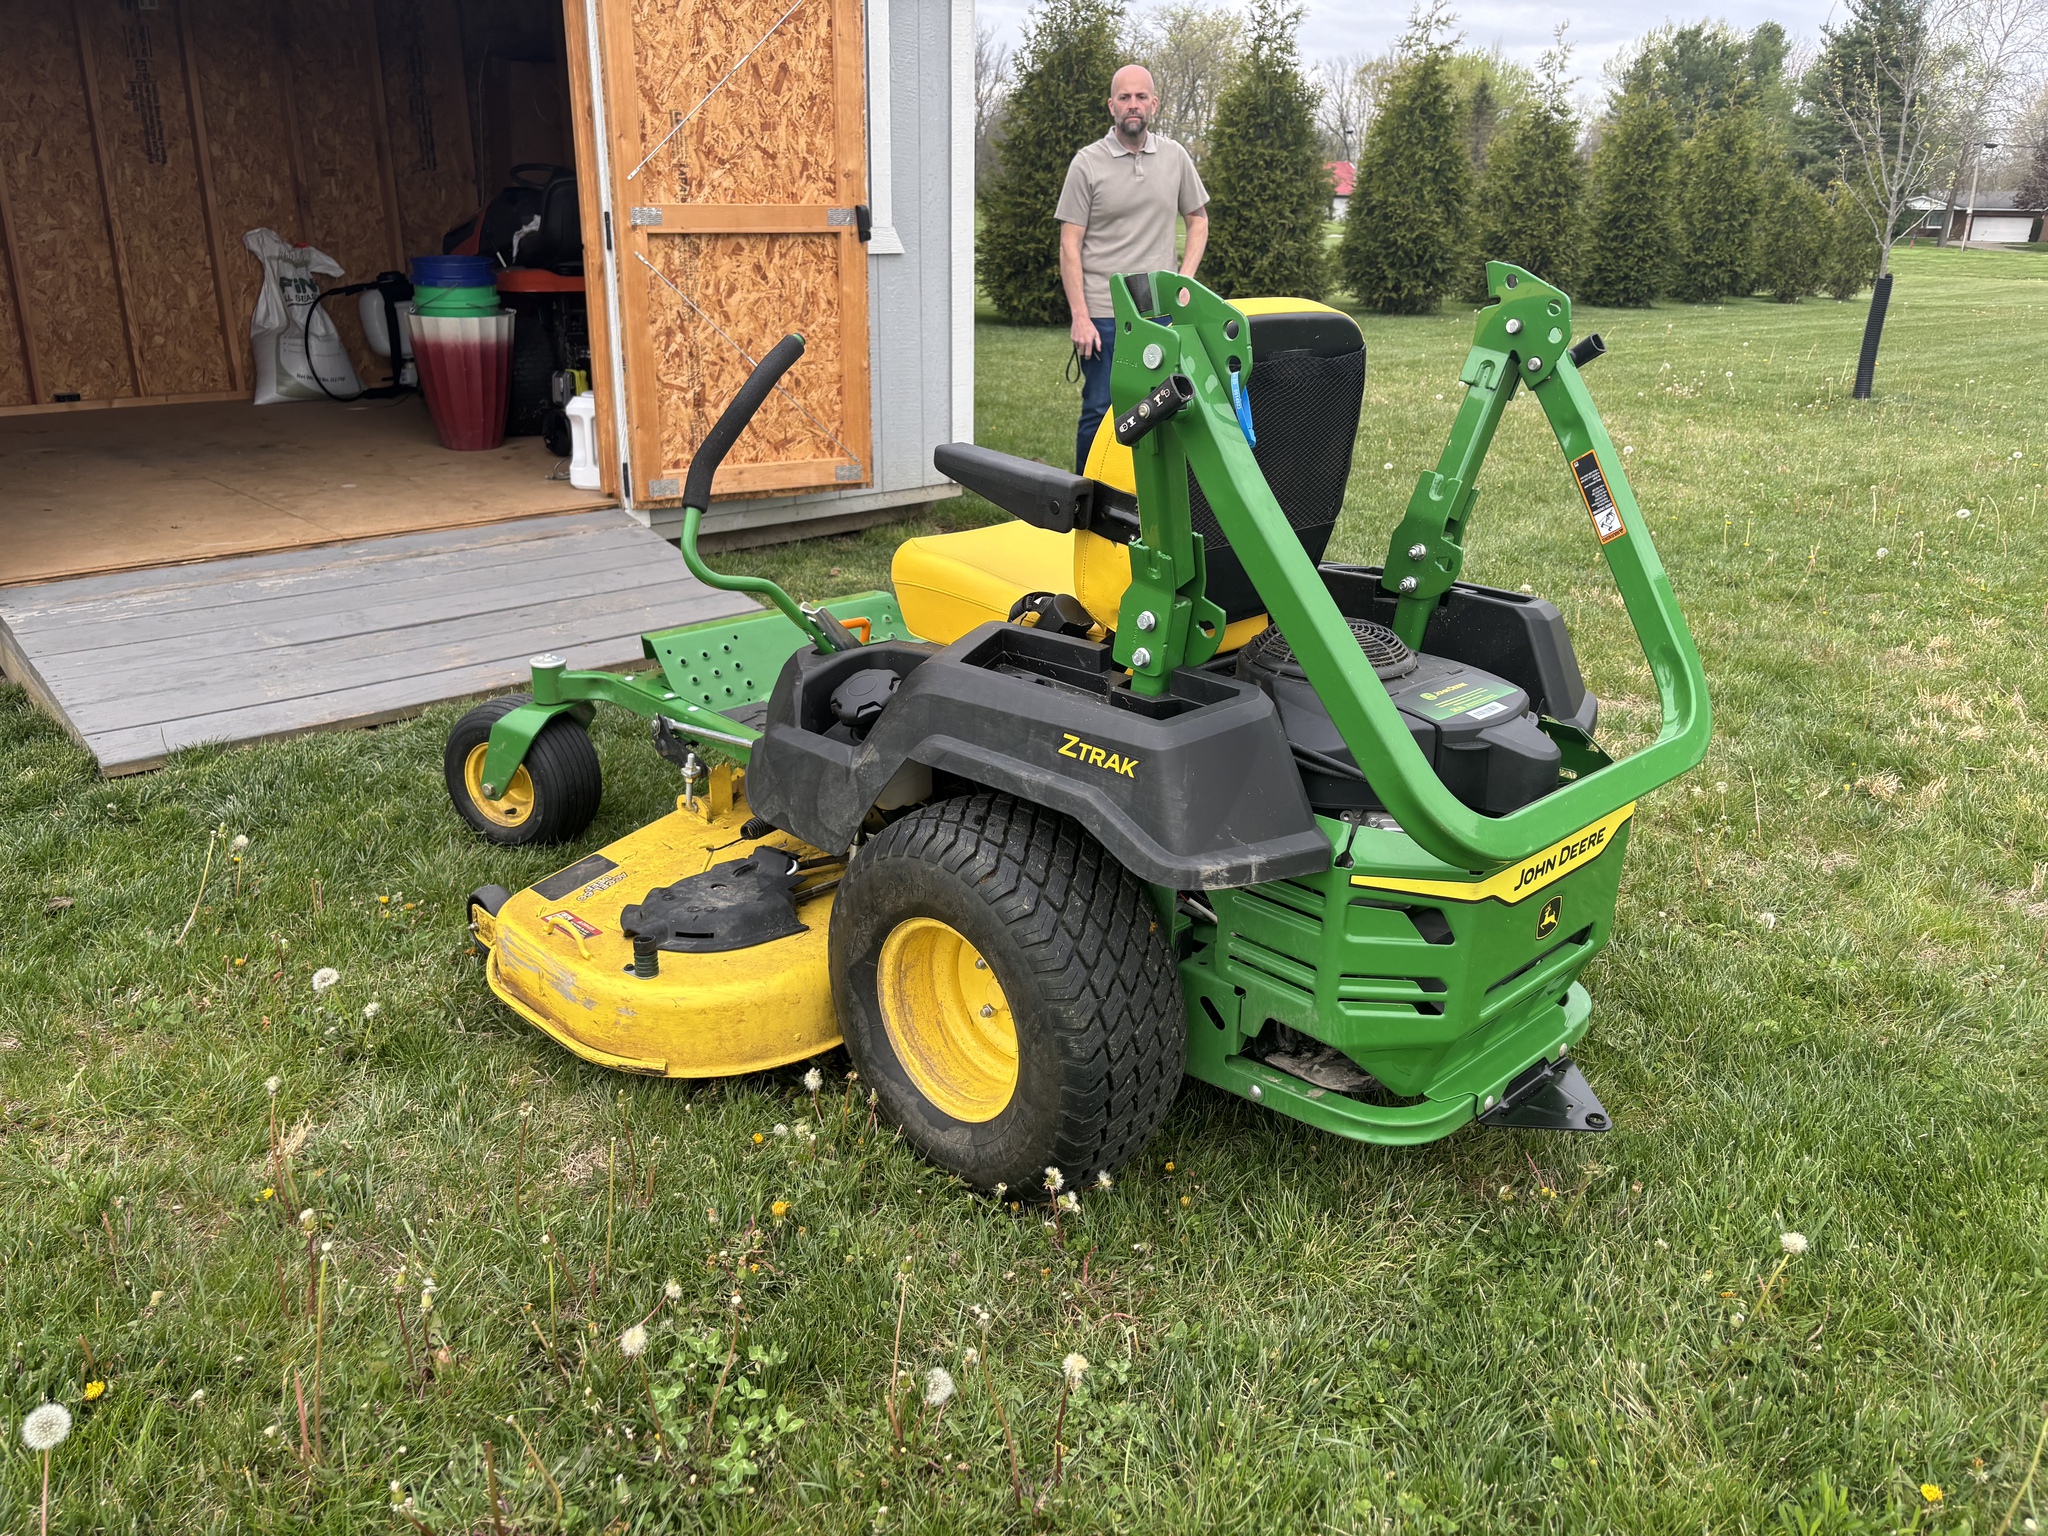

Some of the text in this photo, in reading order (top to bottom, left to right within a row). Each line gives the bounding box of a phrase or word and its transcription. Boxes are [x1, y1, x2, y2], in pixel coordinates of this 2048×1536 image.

[1057, 732, 1139, 779] ZTRAK
[1513, 826, 1607, 892] JOHN DEERE
